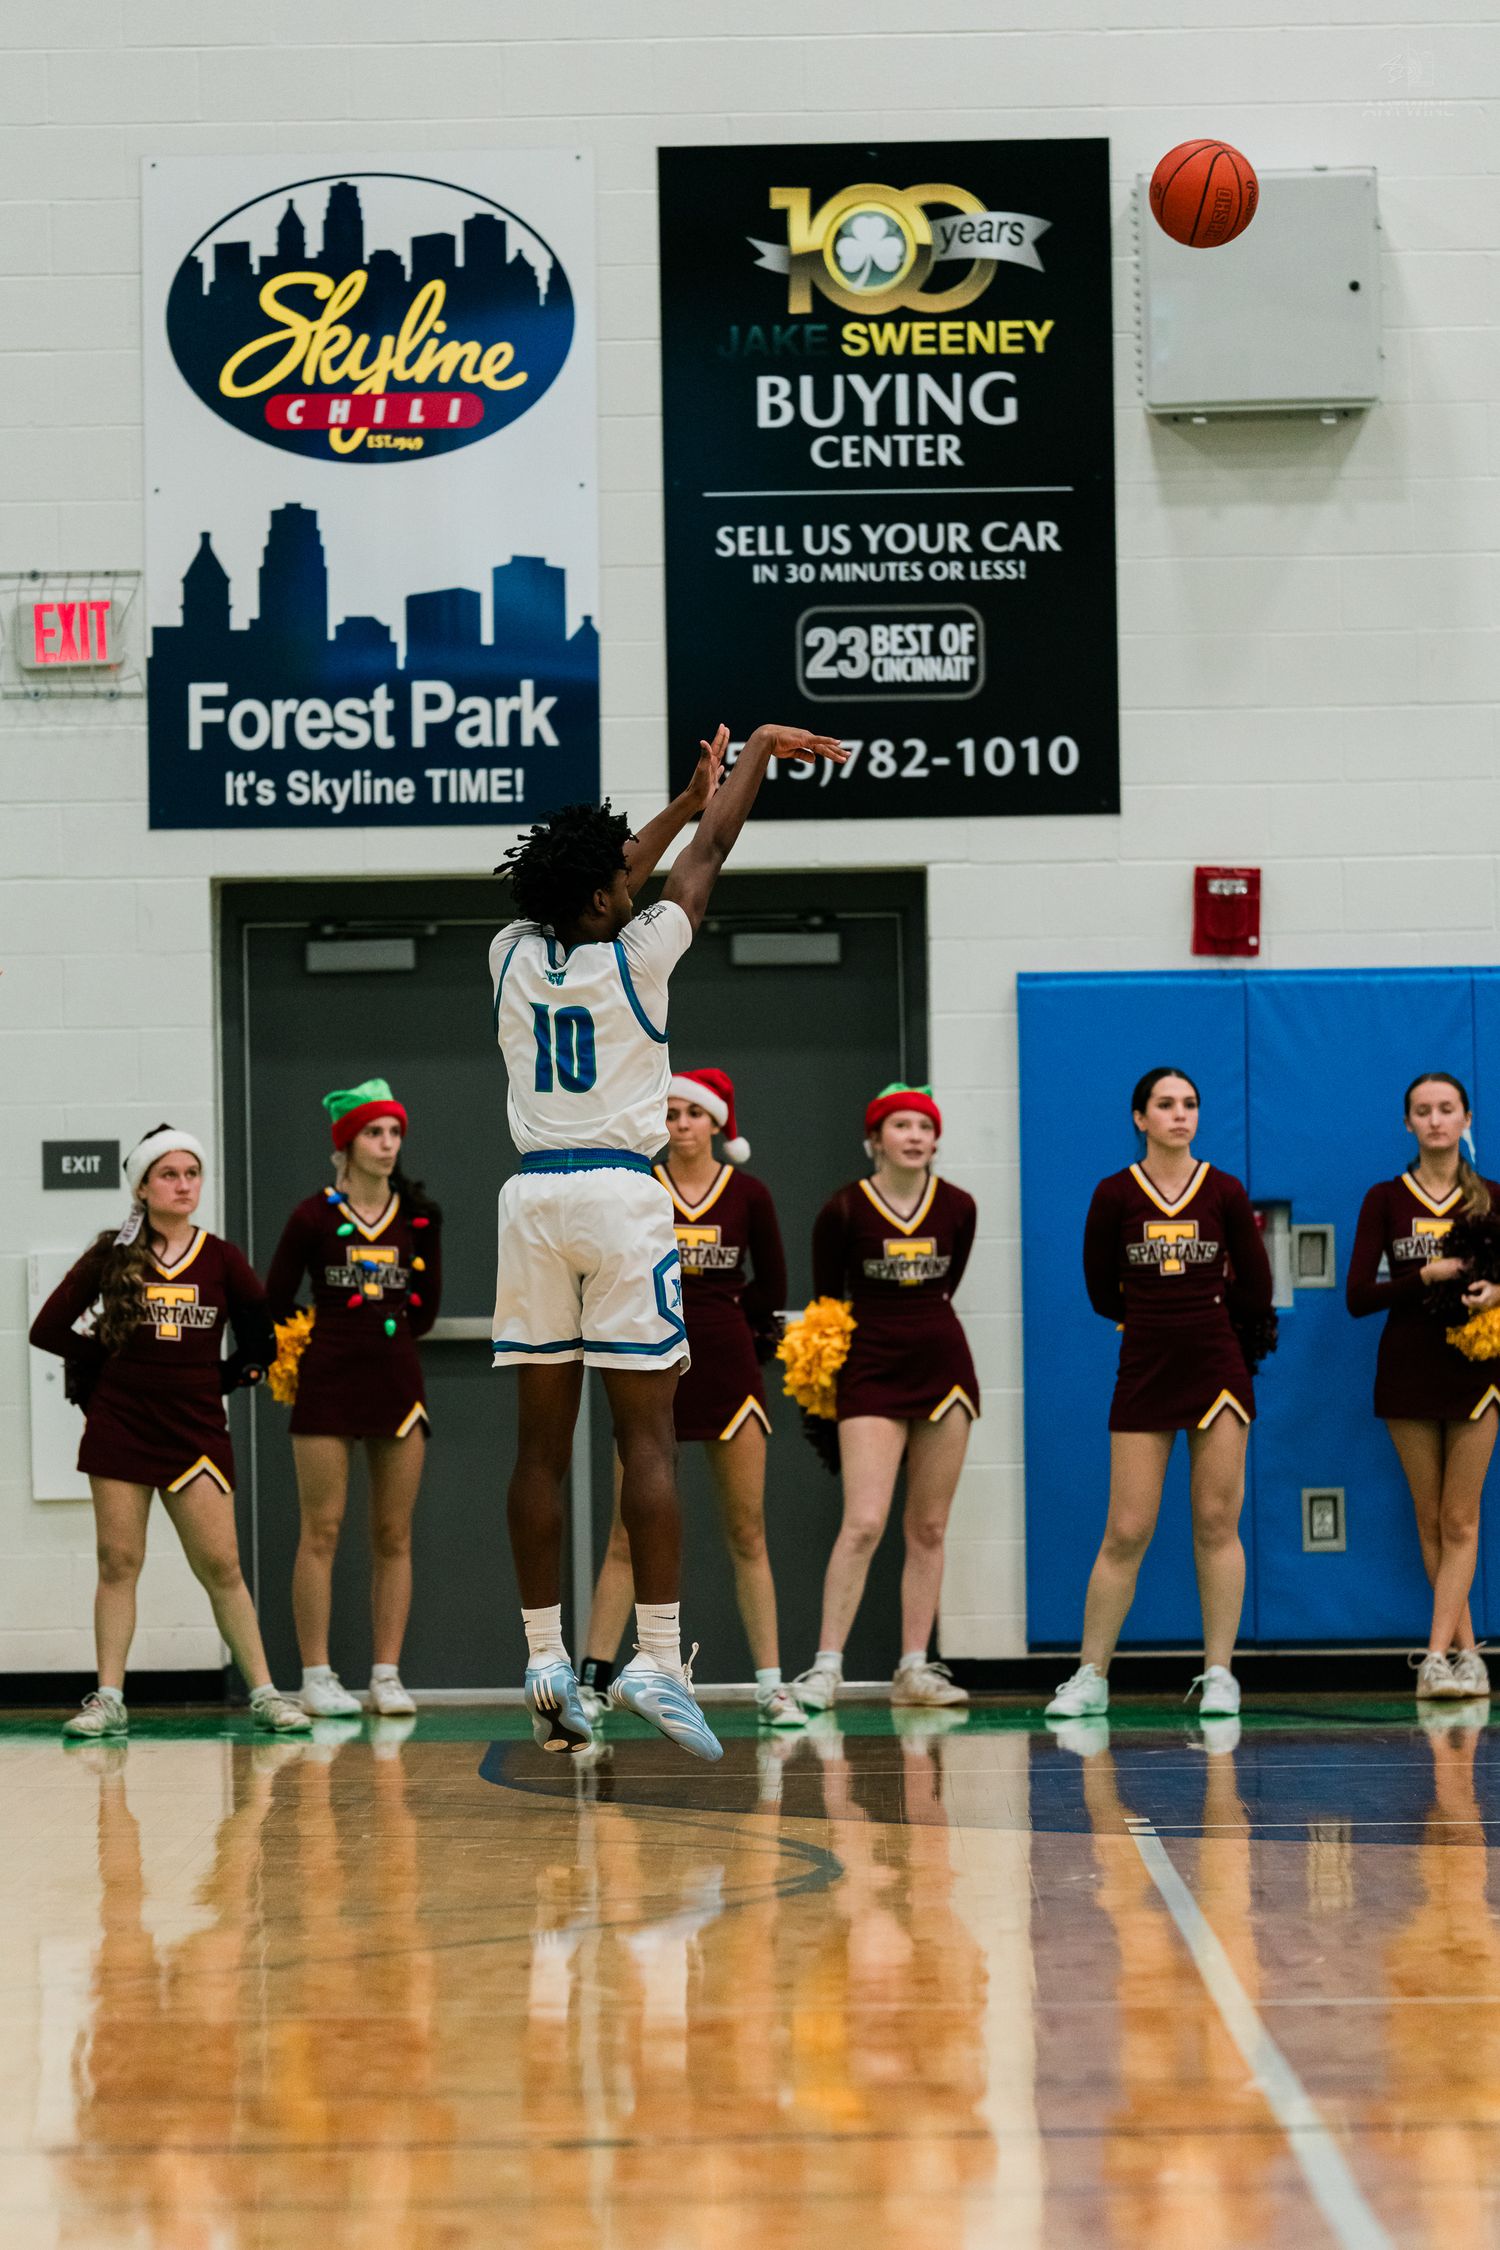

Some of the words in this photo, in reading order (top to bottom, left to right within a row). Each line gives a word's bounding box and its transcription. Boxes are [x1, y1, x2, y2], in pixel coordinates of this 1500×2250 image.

[940, 216, 1026, 254] years
[715, 324, 829, 358] JAKE
[842, 320, 1053, 356] SWEENEY
[219, 270, 527, 453] Skyline
[287, 399, 460, 424] CHILI
[757, 371, 1017, 428] BUYING
[811, 434, 963, 468] CENTER
[716, 526, 792, 557] SELL
[804, 524, 851, 555] US
[861, 523, 972, 554] YOUR
[982, 521, 1061, 552] CAR
[753, 565, 778, 583] IN
[786, 563, 815, 583] 30
[821, 562, 923, 582] MINUTES
[929, 561, 964, 581] OR
[971, 560, 1026, 580] LESS!
[34, 601, 110, 662] EXIT
[871, 624, 933, 656] BEST
[940, 623, 975, 656] OF
[805, 626, 870, 678] 23
[188, 683, 395, 750] Forest
[411, 679, 559, 748] Park
[226, 771, 276, 806] It's
[287, 770, 415, 813] Skyline
[425, 768, 523, 803] TIME!
[529, 1002, 597, 1094] 10
[61, 1155, 101, 1174] EXIT
[679, 1246, 739, 1269] RTANS
[883, 1237, 937, 1288] T
[1126, 1241, 1218, 1264] SPARTANS
[1144, 1220, 1199, 1276] T
[1393, 1237, 1443, 1260] SPAR
[143, 1282, 199, 1341] T
[143, 1304, 218, 1328] ARTANS
